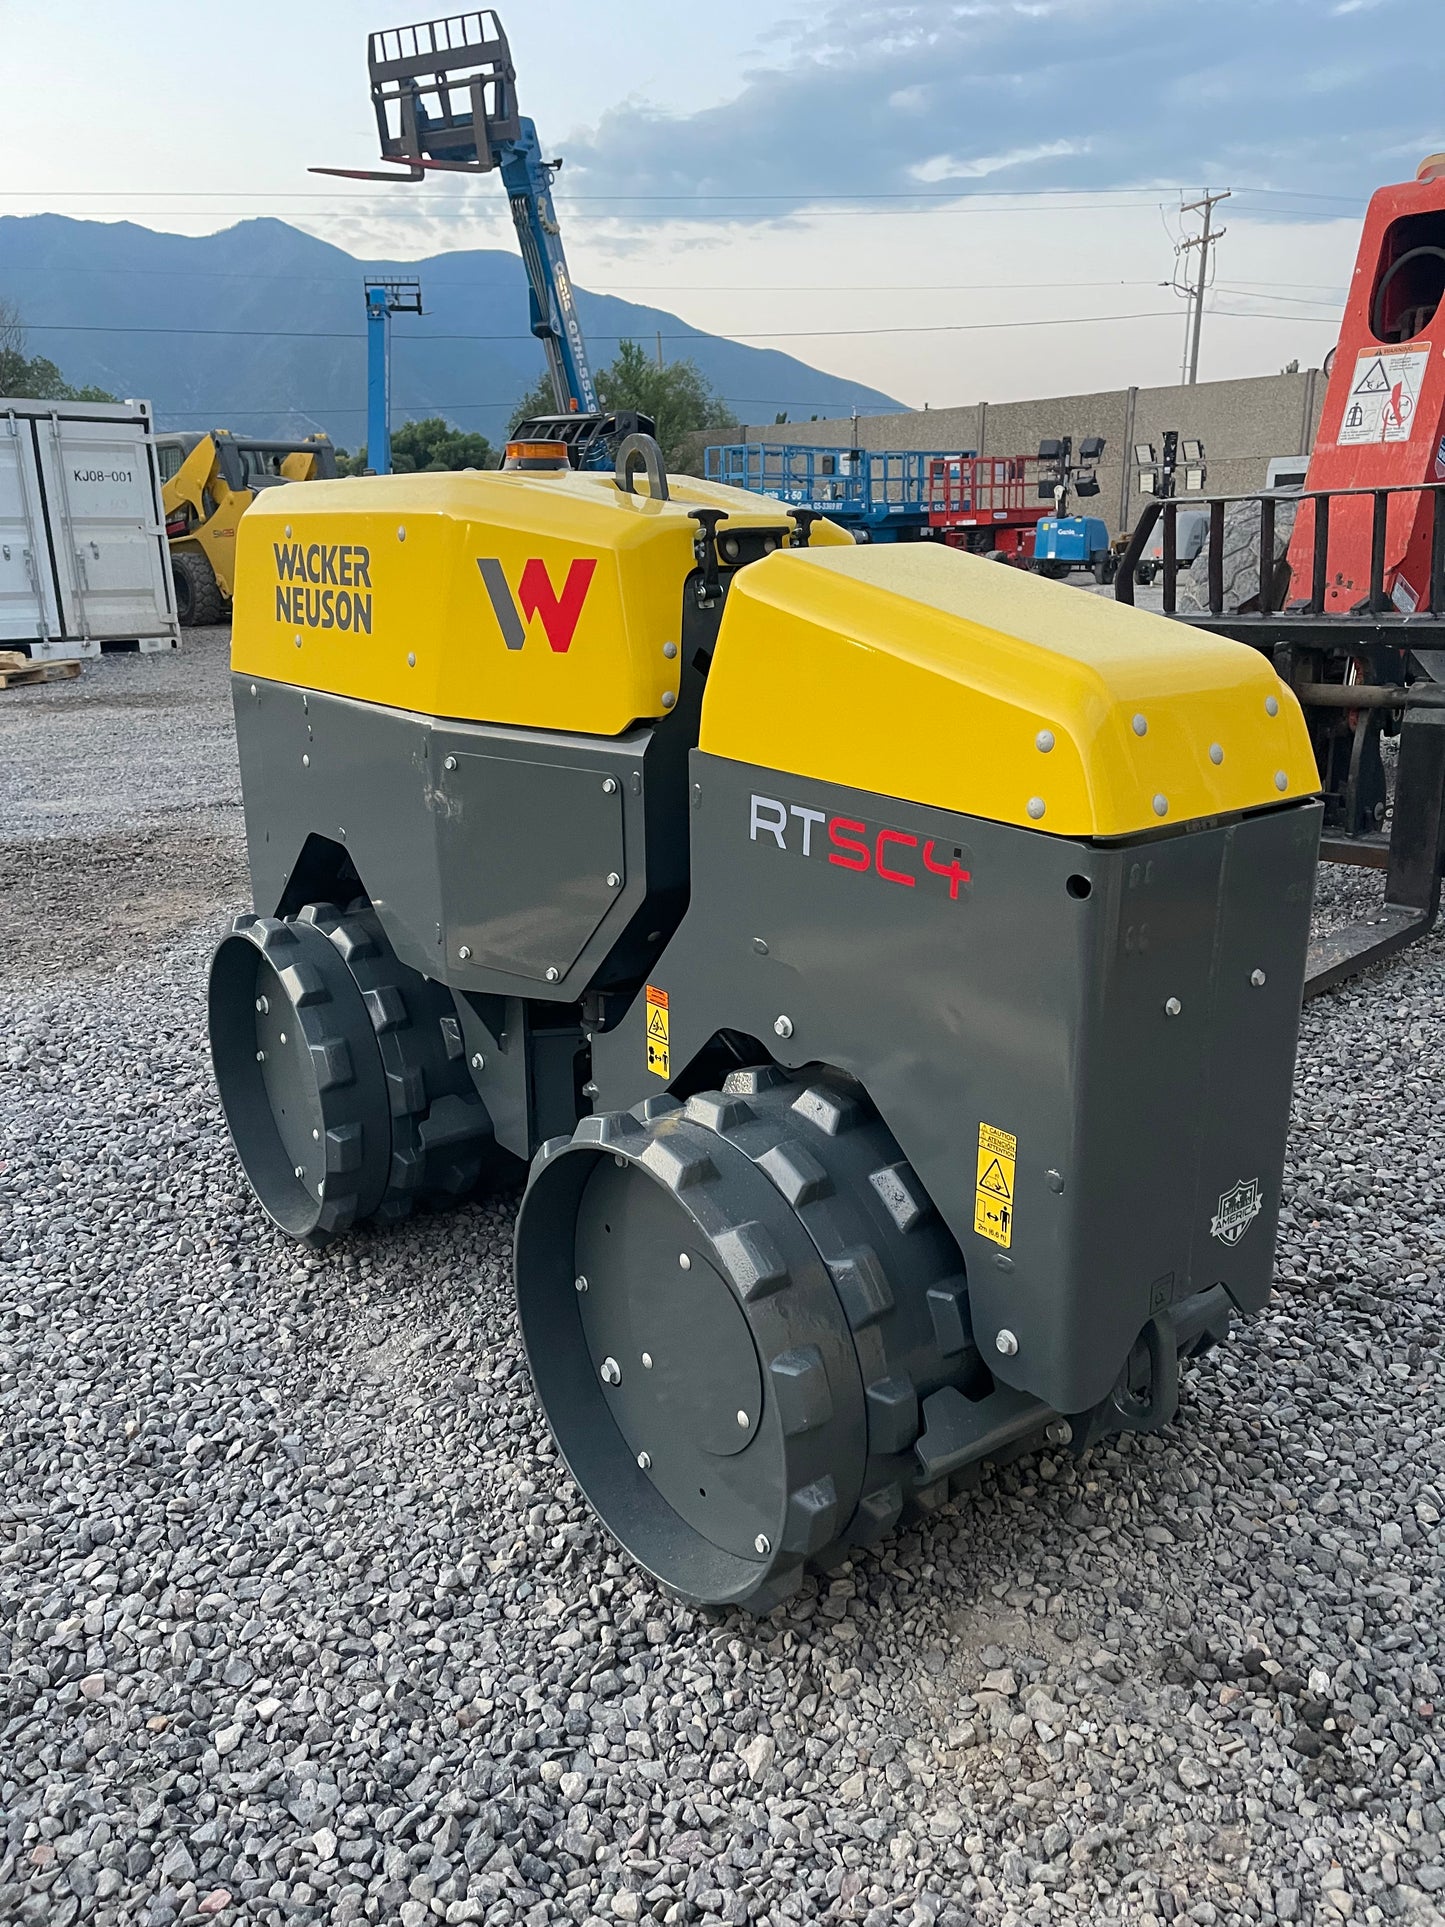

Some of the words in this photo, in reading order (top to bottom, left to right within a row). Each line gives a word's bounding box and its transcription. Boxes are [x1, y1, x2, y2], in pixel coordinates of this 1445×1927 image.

[568, 319, 597, 413] GTH-5519
[73, 470, 132, 482] KJ08-001
[273, 543, 372, 588] WACKER
[276, 585, 372, 635] NEUSON
[989, 1127, 1015, 1143] CAUTION
[987, 1142, 1015, 1158] ATTENTION
[978, 1223, 988, 1233] 2m
[1215, 1203, 1257, 1231] AMERICA
